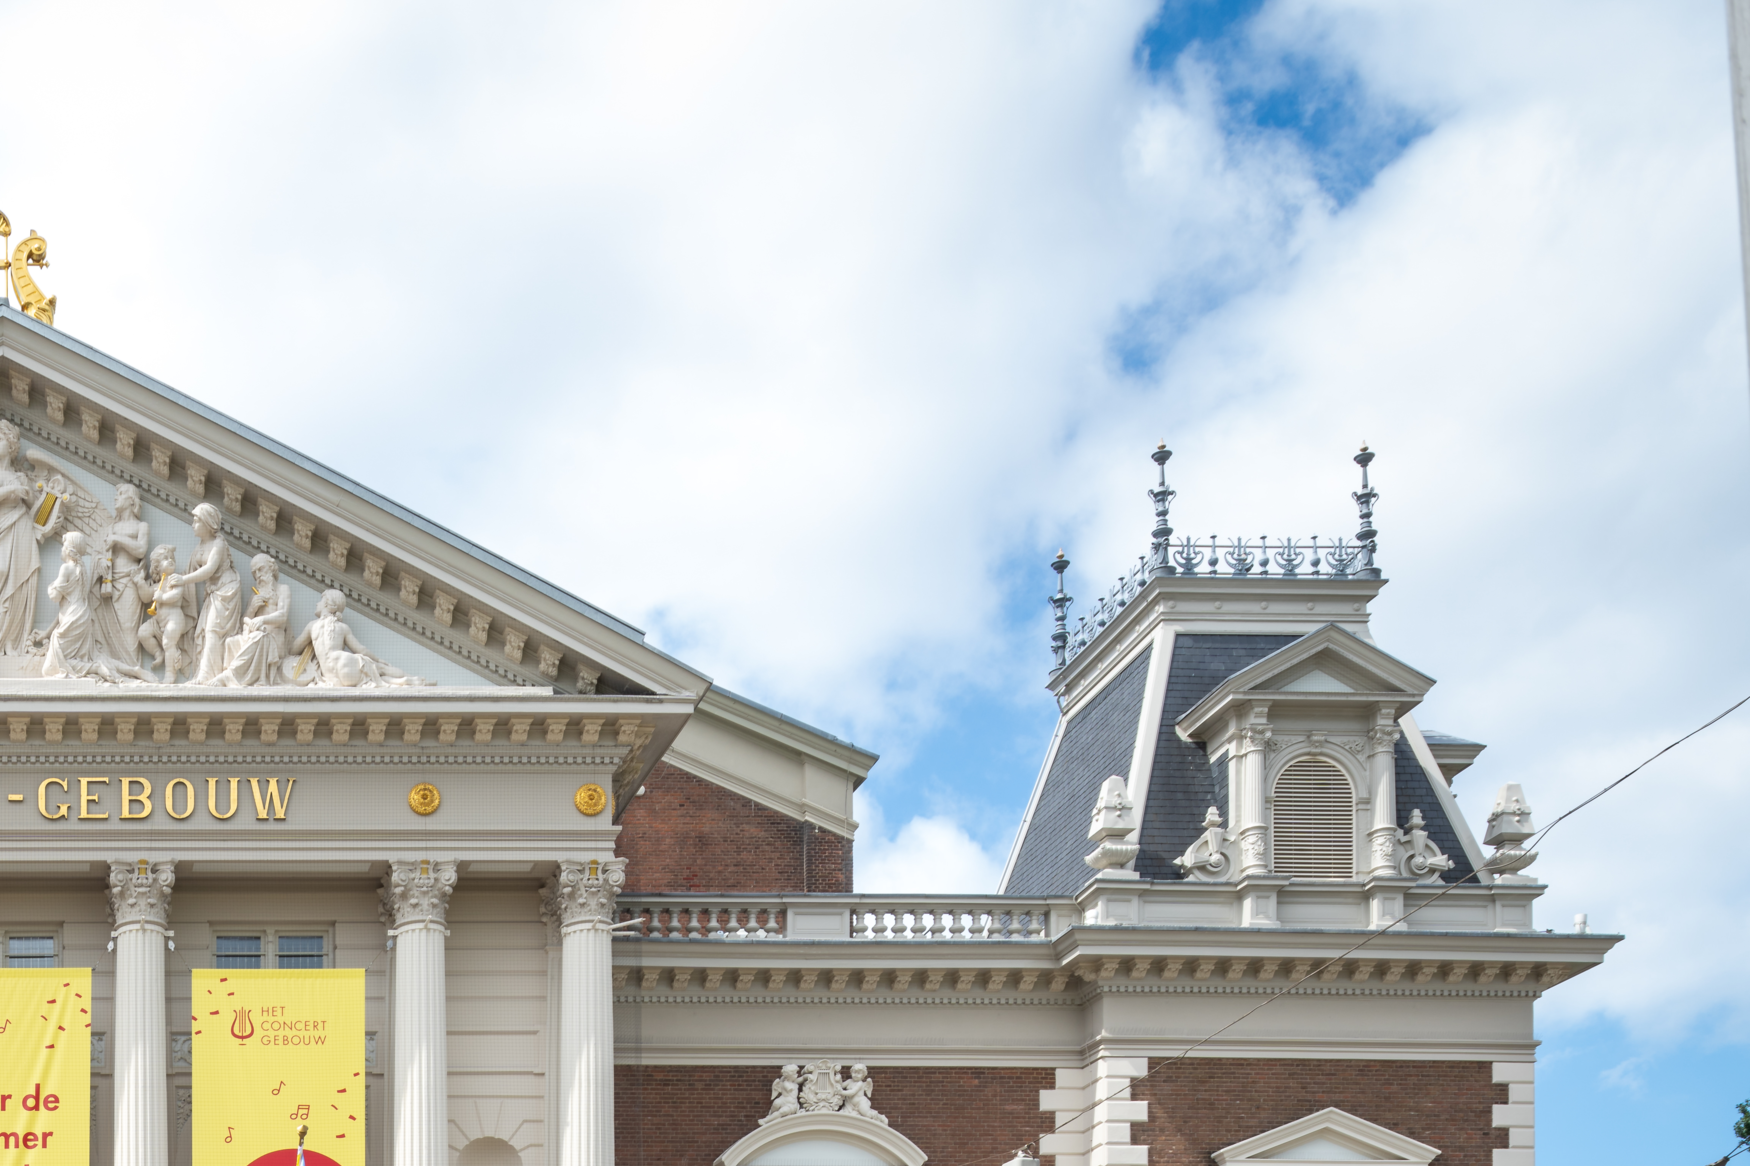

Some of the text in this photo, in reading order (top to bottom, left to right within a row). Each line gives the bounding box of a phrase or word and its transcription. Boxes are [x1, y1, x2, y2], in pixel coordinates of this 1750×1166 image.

[261, 1006, 286, 1017] HET
[260, 1020, 327, 1032] CONCERT
[260, 1035, 327, 1046] GEBOUW
[21, 1083, 60, 1112] de
